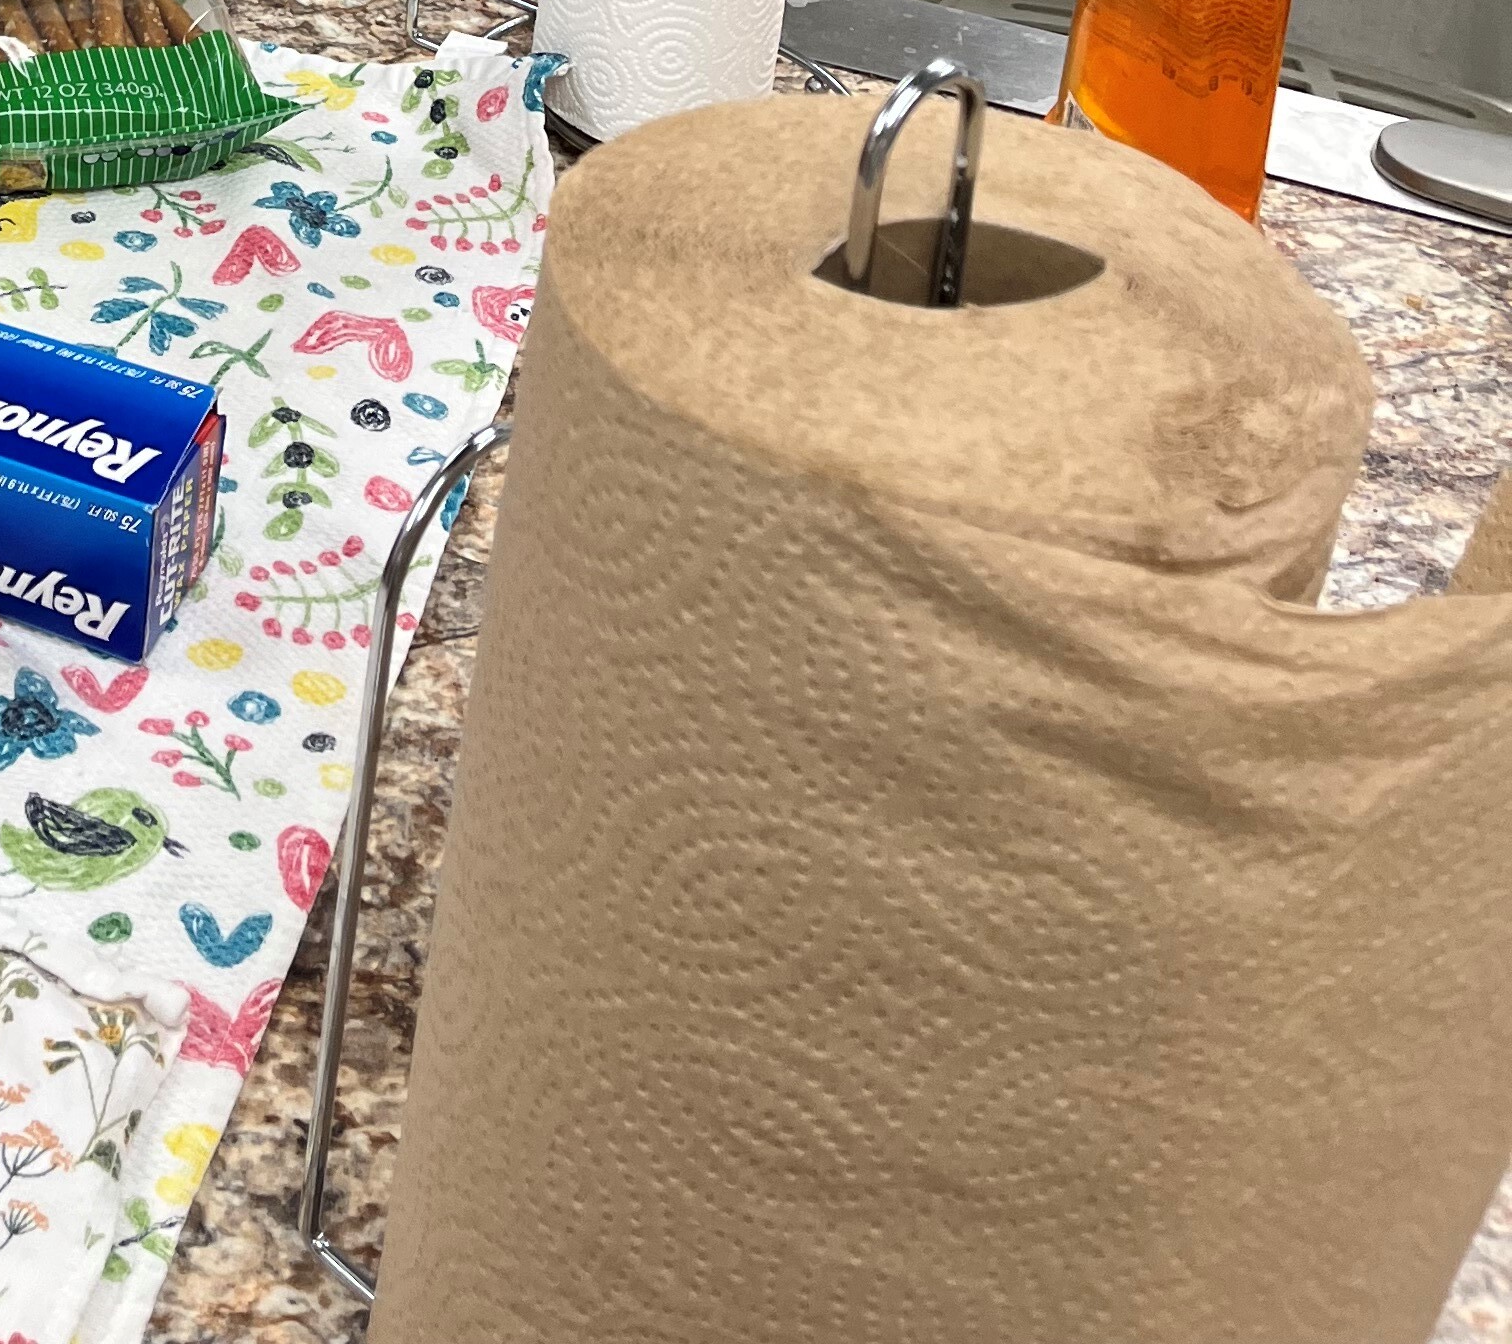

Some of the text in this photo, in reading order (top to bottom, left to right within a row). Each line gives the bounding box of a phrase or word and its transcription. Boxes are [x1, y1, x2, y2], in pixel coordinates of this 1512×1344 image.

[32, 85, 54, 99] 12
[59, 83, 91, 97] OZ
[118, 514, 143, 534] 75
[159, 485, 185, 626] CUT-RITE
